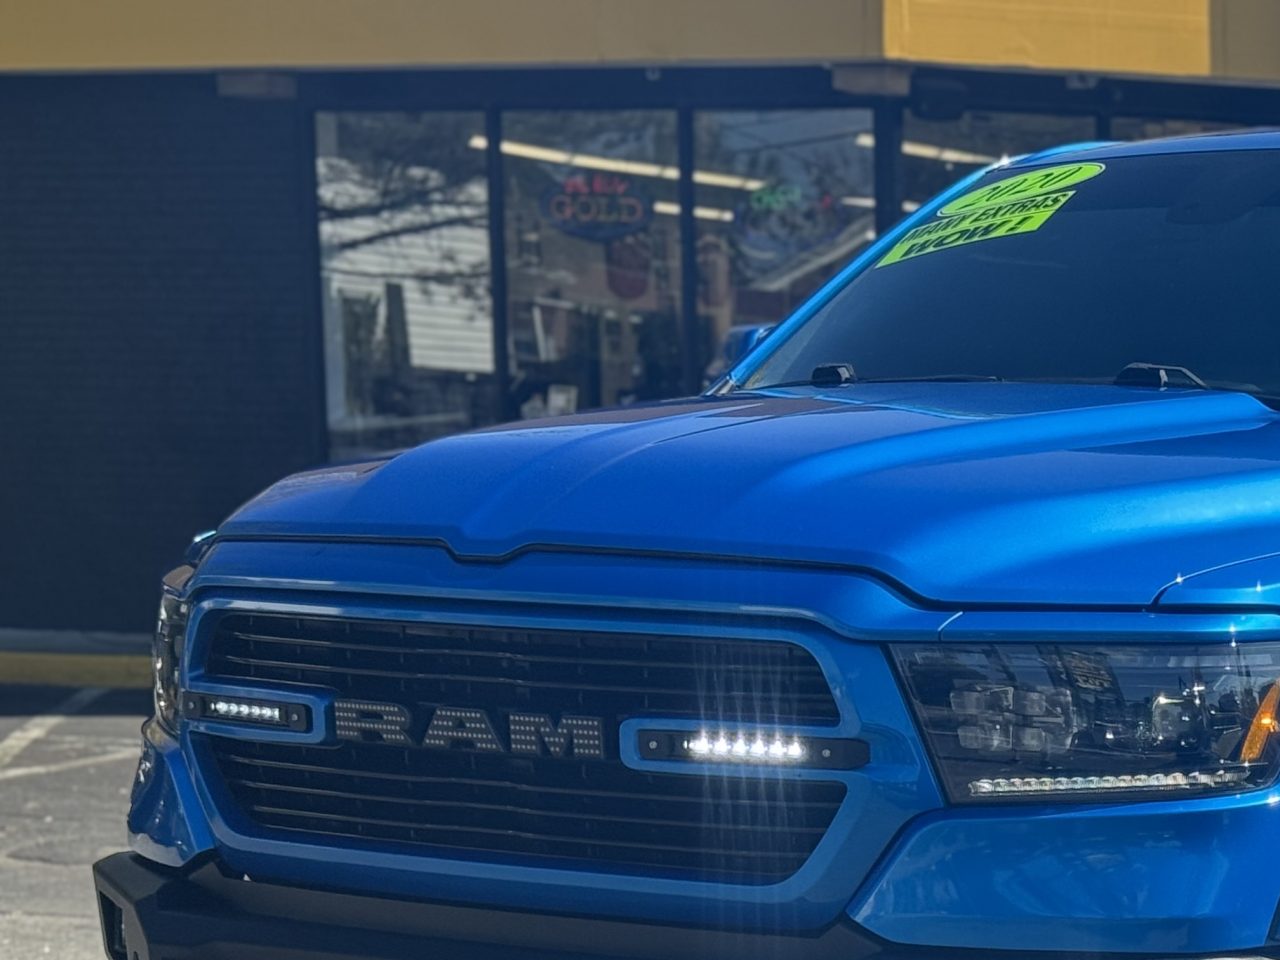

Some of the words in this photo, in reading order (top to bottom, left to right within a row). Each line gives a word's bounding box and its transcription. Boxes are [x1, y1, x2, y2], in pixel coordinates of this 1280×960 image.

[957, 166, 1083, 211] 2020
[903, 212, 976, 243] MANY
[969, 192, 1068, 223] EXTRAS
[334, 699, 605, 758] RAM
